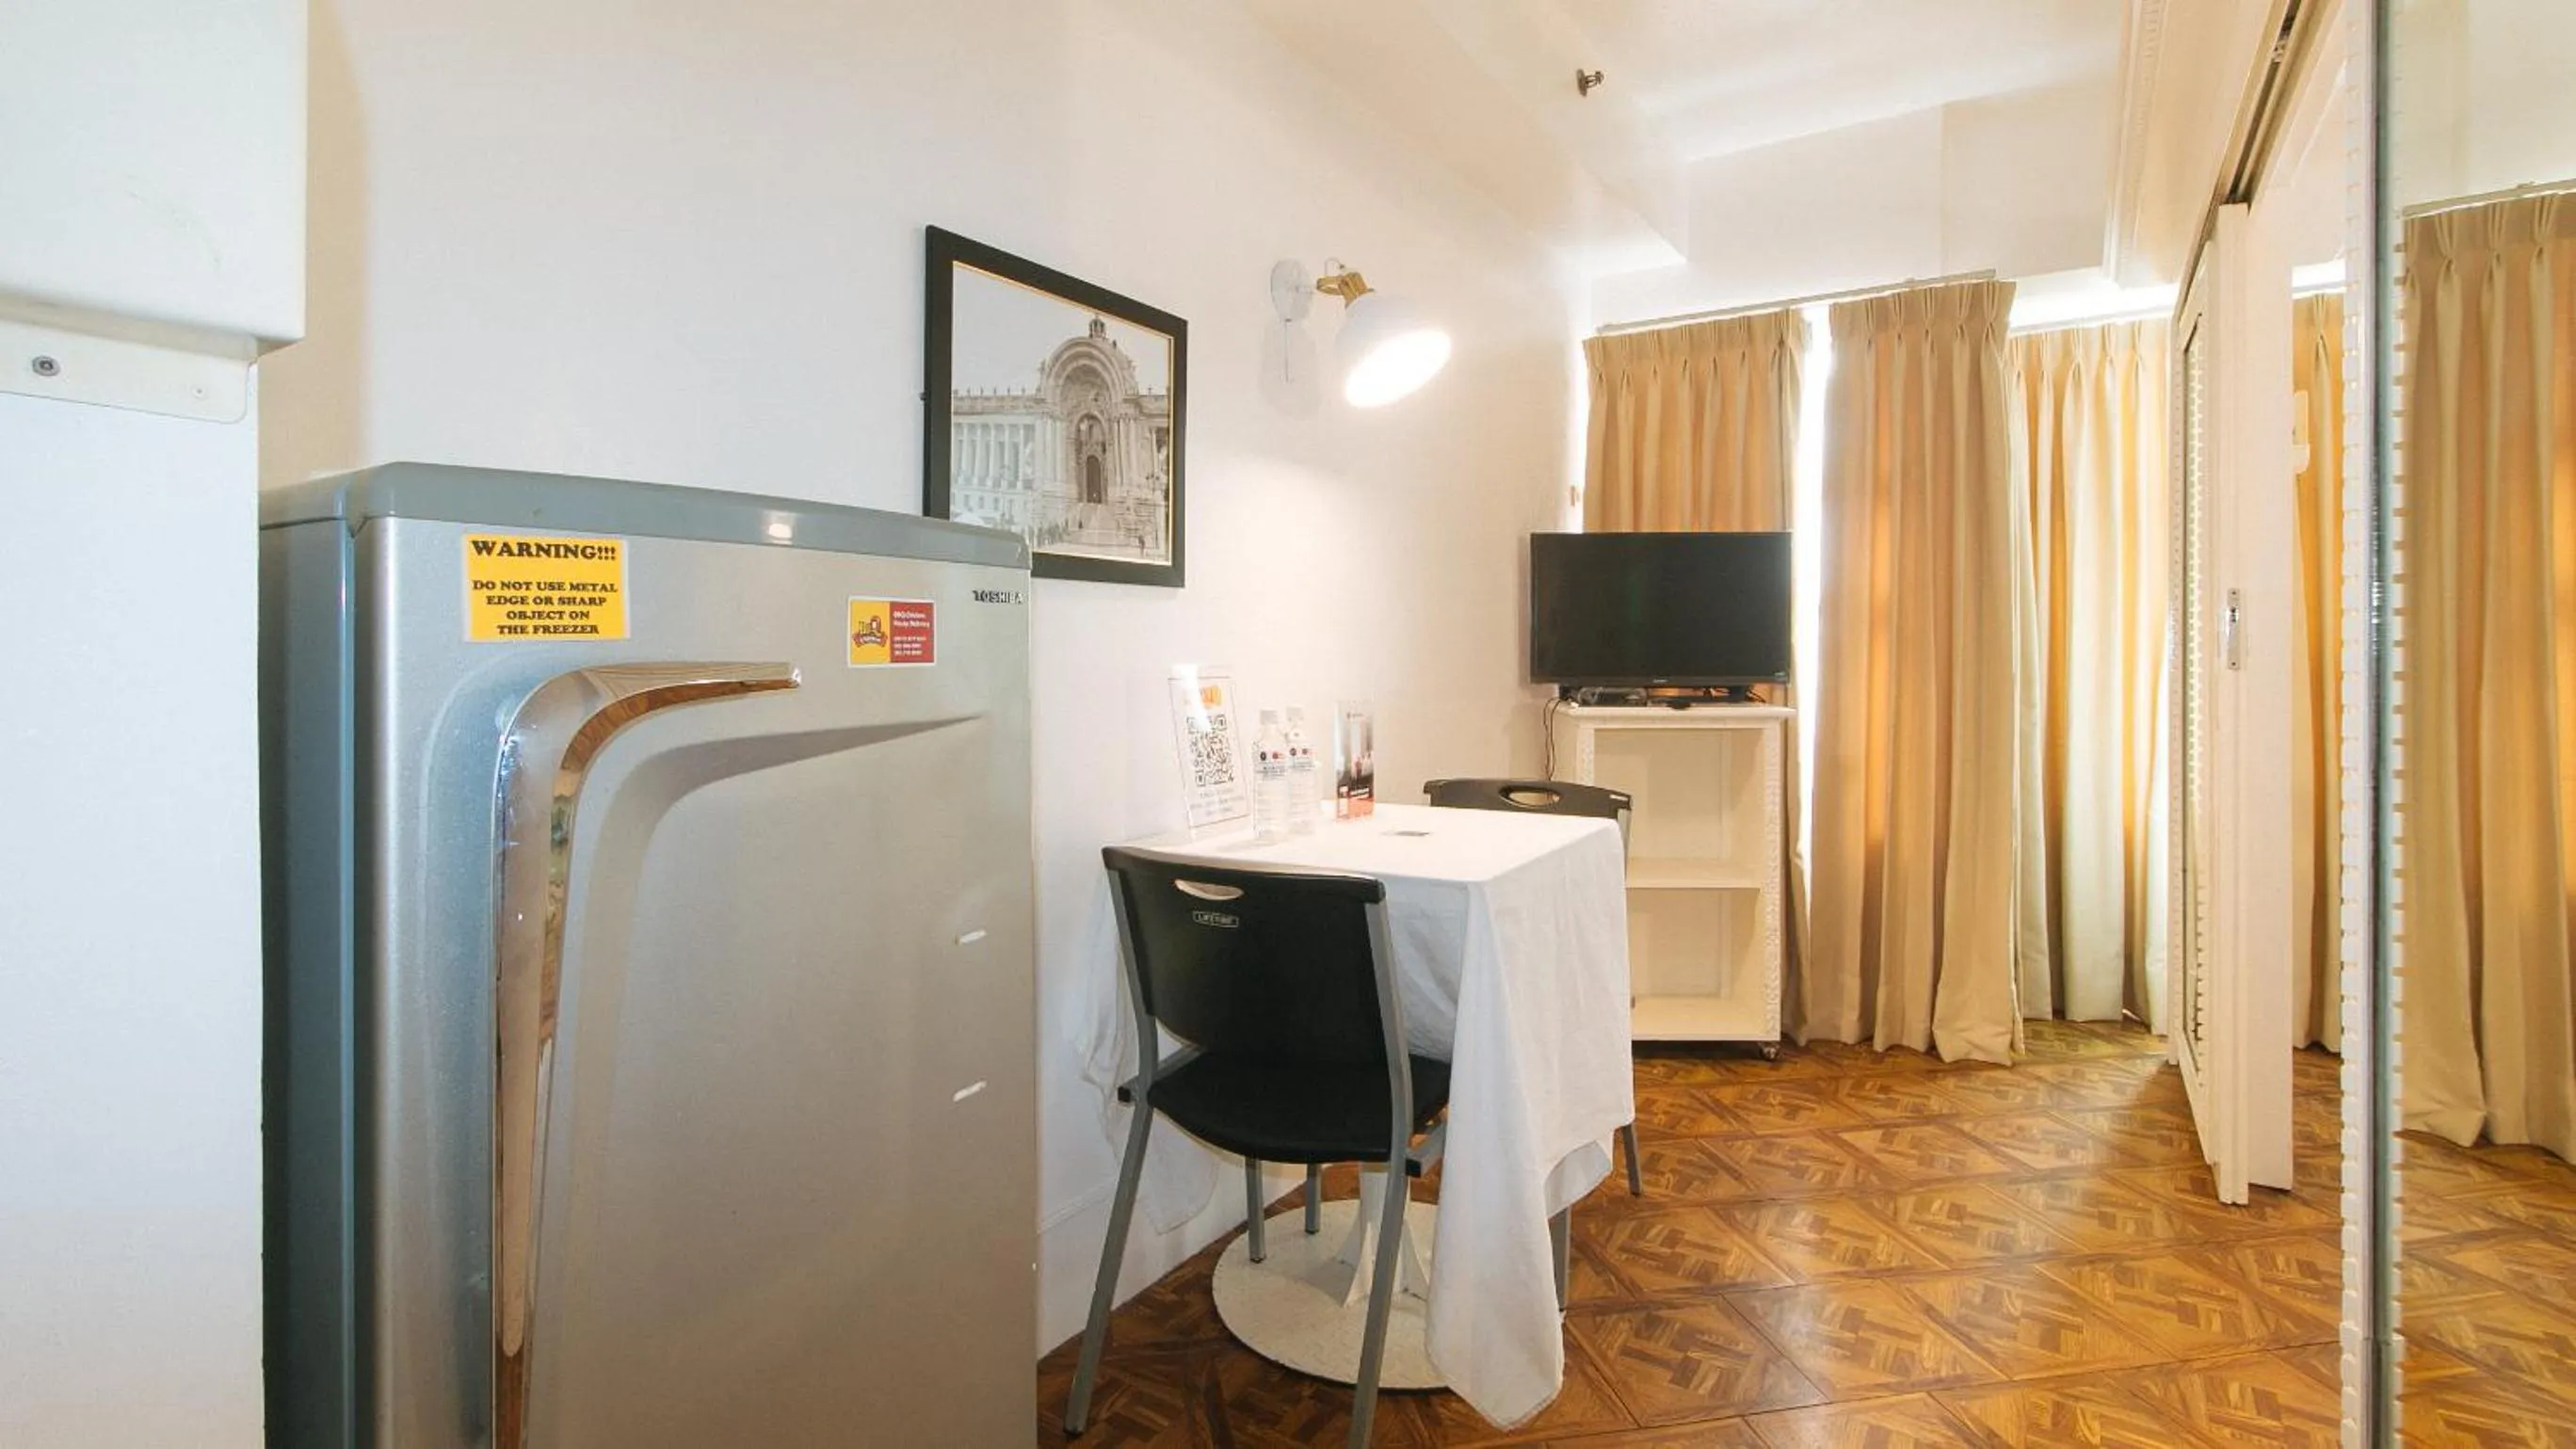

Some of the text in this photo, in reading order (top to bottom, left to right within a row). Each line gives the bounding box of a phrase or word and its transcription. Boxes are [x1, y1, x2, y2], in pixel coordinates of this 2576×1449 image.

[471, 539, 616, 560] WARNING!!!
[473, 579, 618, 593] DO NOT USE METAL
[486, 595, 606, 606] EDGE OR SHARP
[506, 610, 590, 620] OBJECT ON
[496, 624, 600, 635] THE FREEZER
